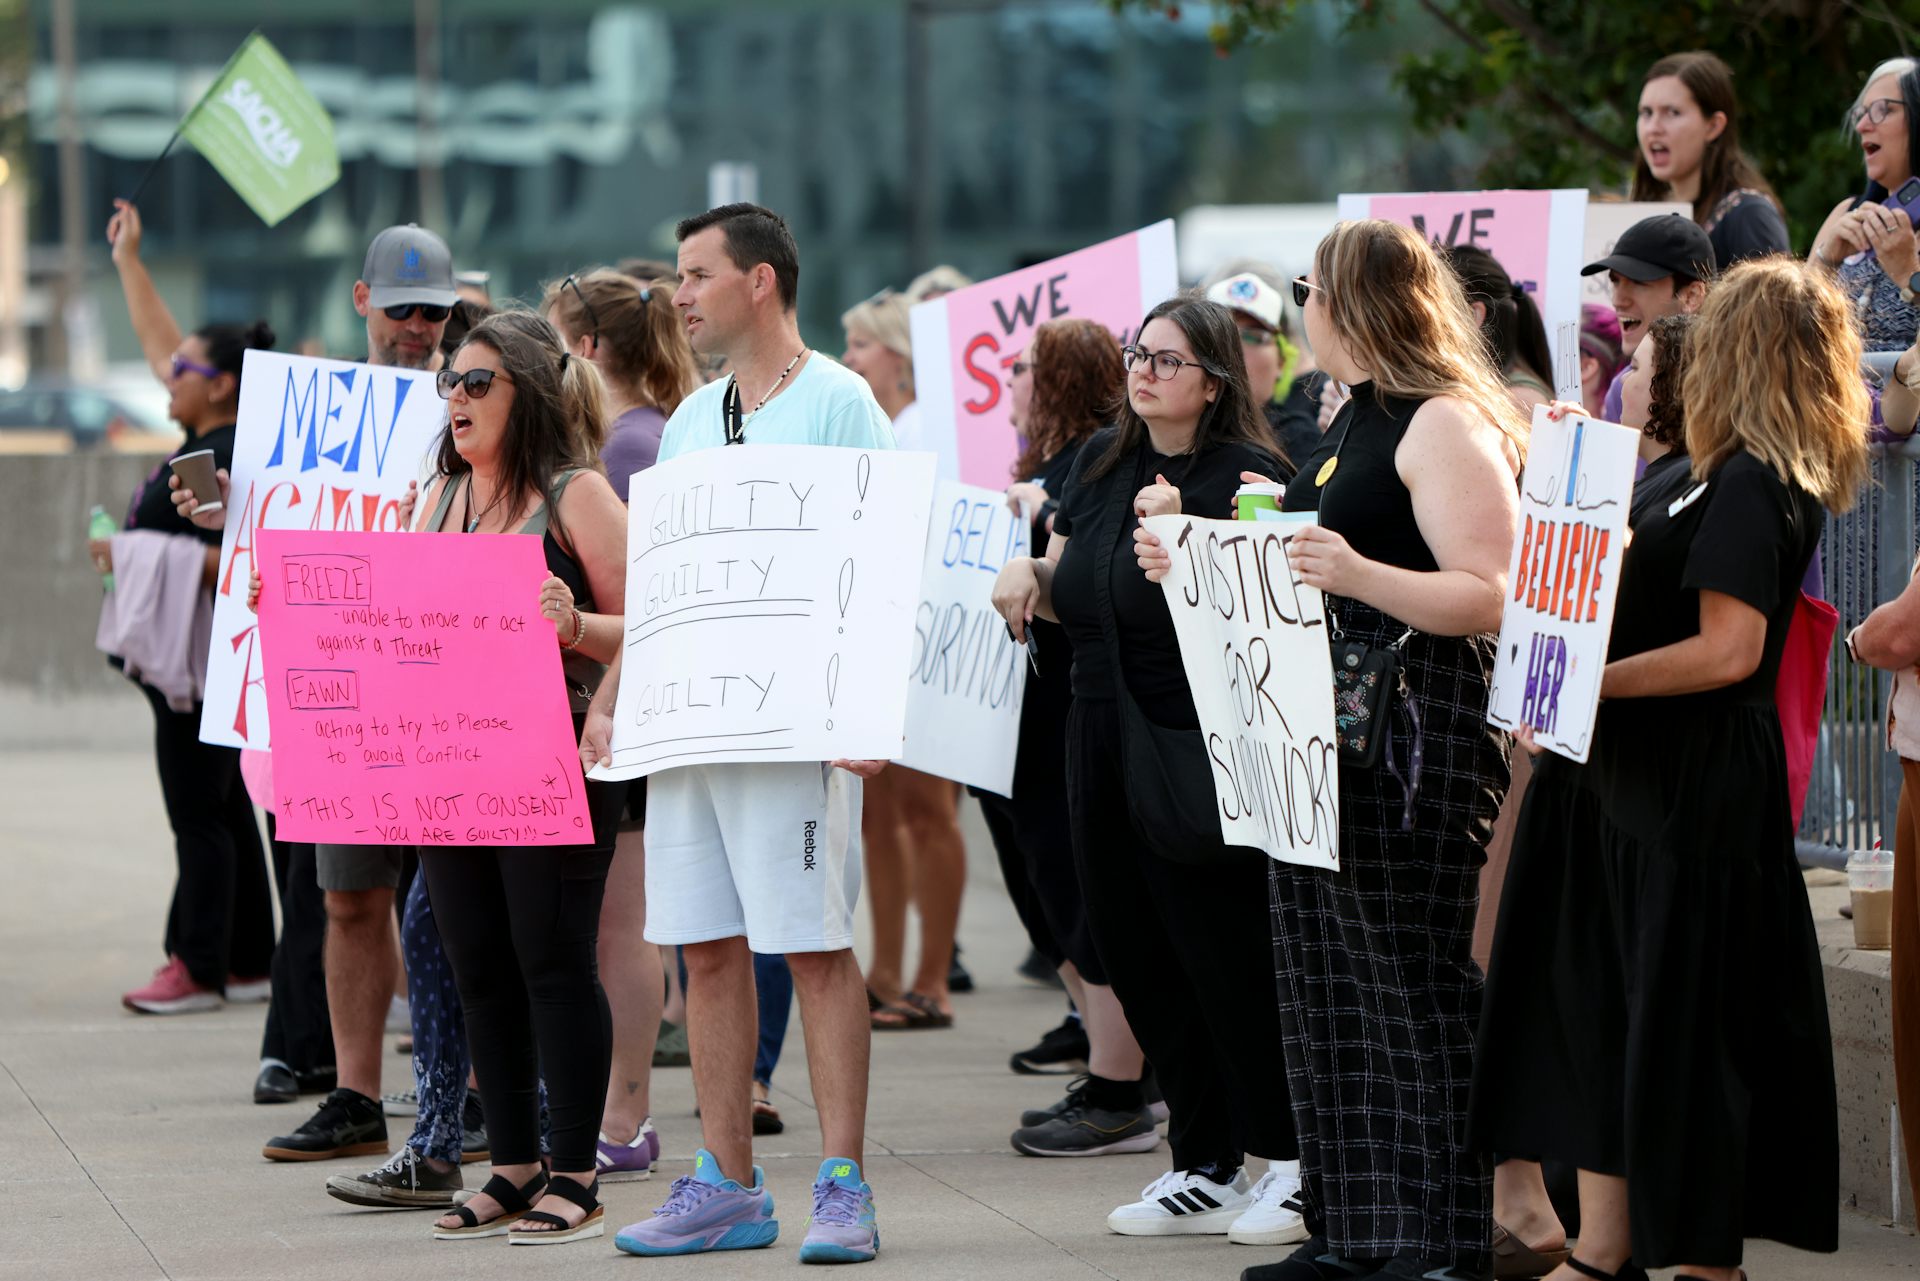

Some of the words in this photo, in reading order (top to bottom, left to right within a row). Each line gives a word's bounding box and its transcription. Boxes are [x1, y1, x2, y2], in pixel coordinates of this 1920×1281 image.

[992, 272, 1070, 335] WE
[265, 366, 414, 478] MEN
[650, 480, 815, 545] GUILTY
[285, 563, 368, 601] FREEZE
[644, 555, 775, 616] GUILTY
[1177, 520, 1322, 629] JUSTICE
[1514, 513, 1610, 624] BELIEVE
[393, 606, 413, 629] to
[420, 610, 460, 629] move
[473, 614, 489, 630] or
[500, 614, 526, 632] act
[316, 634, 367, 661] against
[373, 639, 383, 655] a
[390, 636, 443, 660] Threat
[291, 675, 351, 704] FAWN
[636, 672, 776, 728] GUILTY
[1224, 636, 1294, 740] FOR
[1519, 631, 1567, 737] HER
[315, 719, 364, 747] acting
[371, 716, 390, 737] to
[397, 714, 423, 742] try
[431, 713, 450, 733] to
[456, 712, 513, 732] Please
[327, 746, 347, 765] to
[363, 746, 405, 764] avoid
[300, 797, 354, 822] THIS
[373, 792, 400, 821] IS
[415, 793, 465, 822] NOT
[476, 792, 569, 817] CONSENT
[375, 824, 408, 843] YOU
[422, 827, 456, 843] ARE
[804, 820, 817, 872] Reebok
